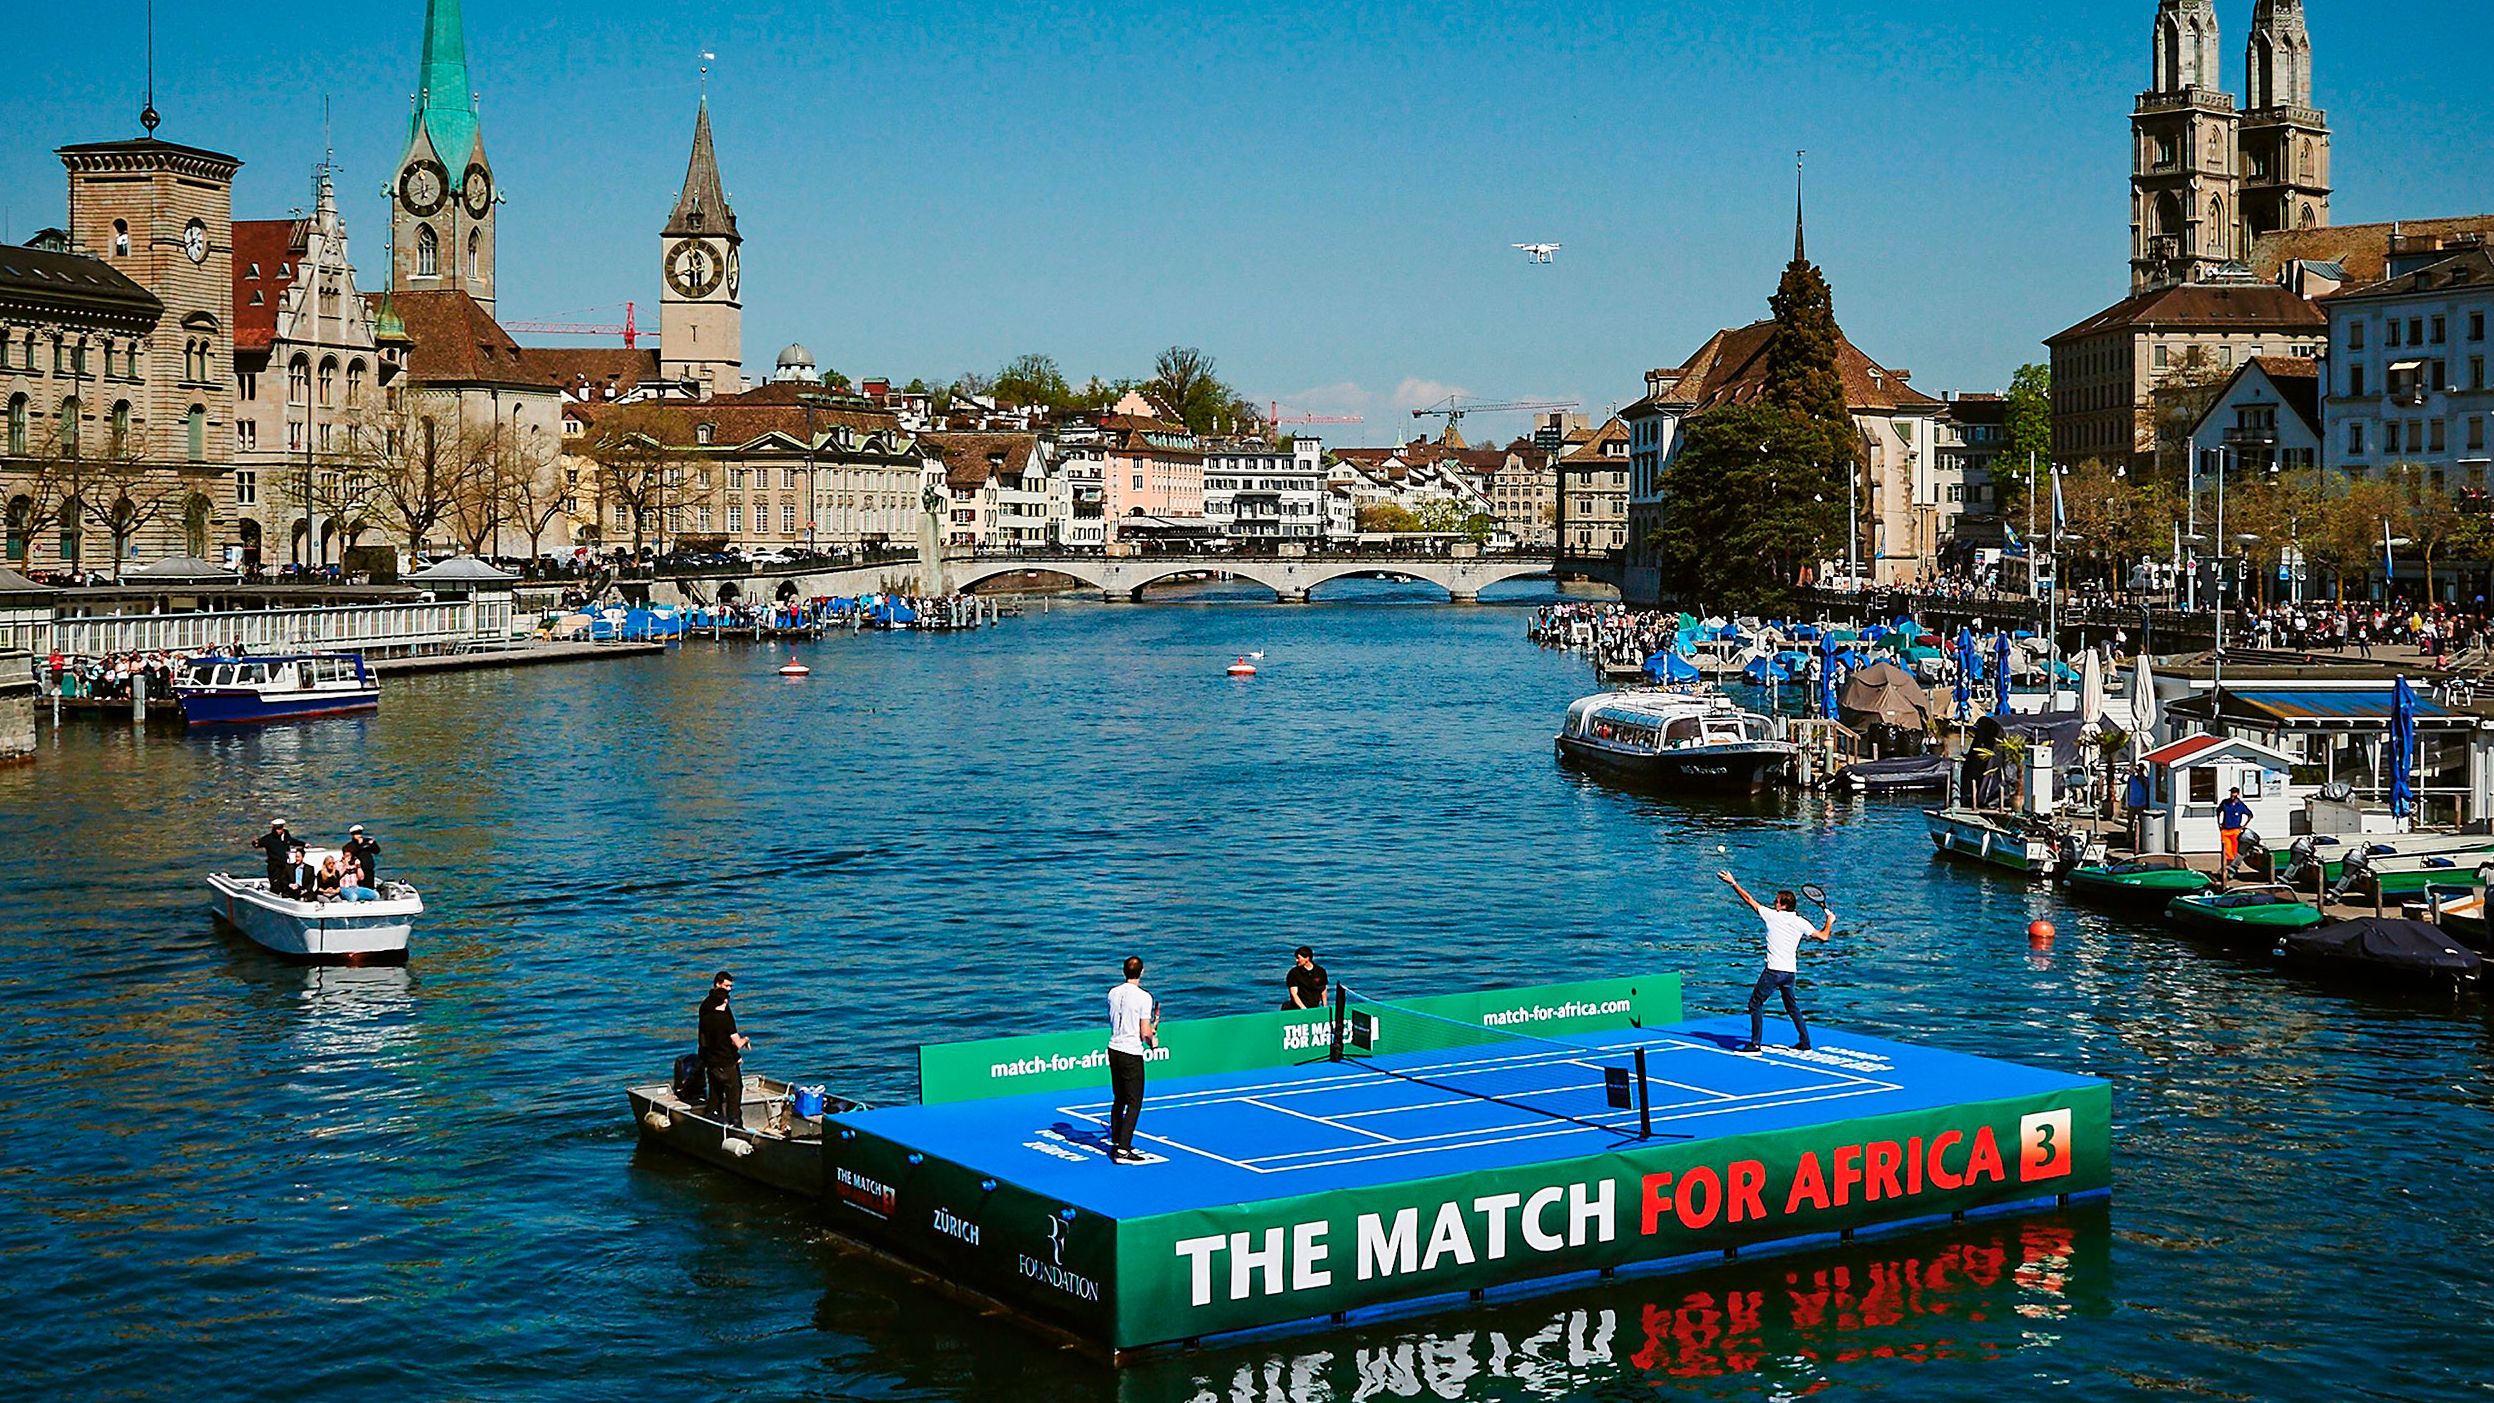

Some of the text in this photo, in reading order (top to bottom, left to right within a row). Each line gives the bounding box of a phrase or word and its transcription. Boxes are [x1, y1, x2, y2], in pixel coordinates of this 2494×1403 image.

[1483, 999, 1631, 1026] match-for-africa.com
[1283, 1023, 1309, 1039] THE
[1283, 1036, 1309, 1050] FOR
[836, 1167, 852, 1185] THE
[853, 1173, 882, 1197] MATCH
[932, 1207, 980, 1246] ZÜRICH
[1175, 1123, 2057, 1306] THE MATCH FOR AFRICA 3
[1019, 1253, 1099, 1301] FOUNDATION
